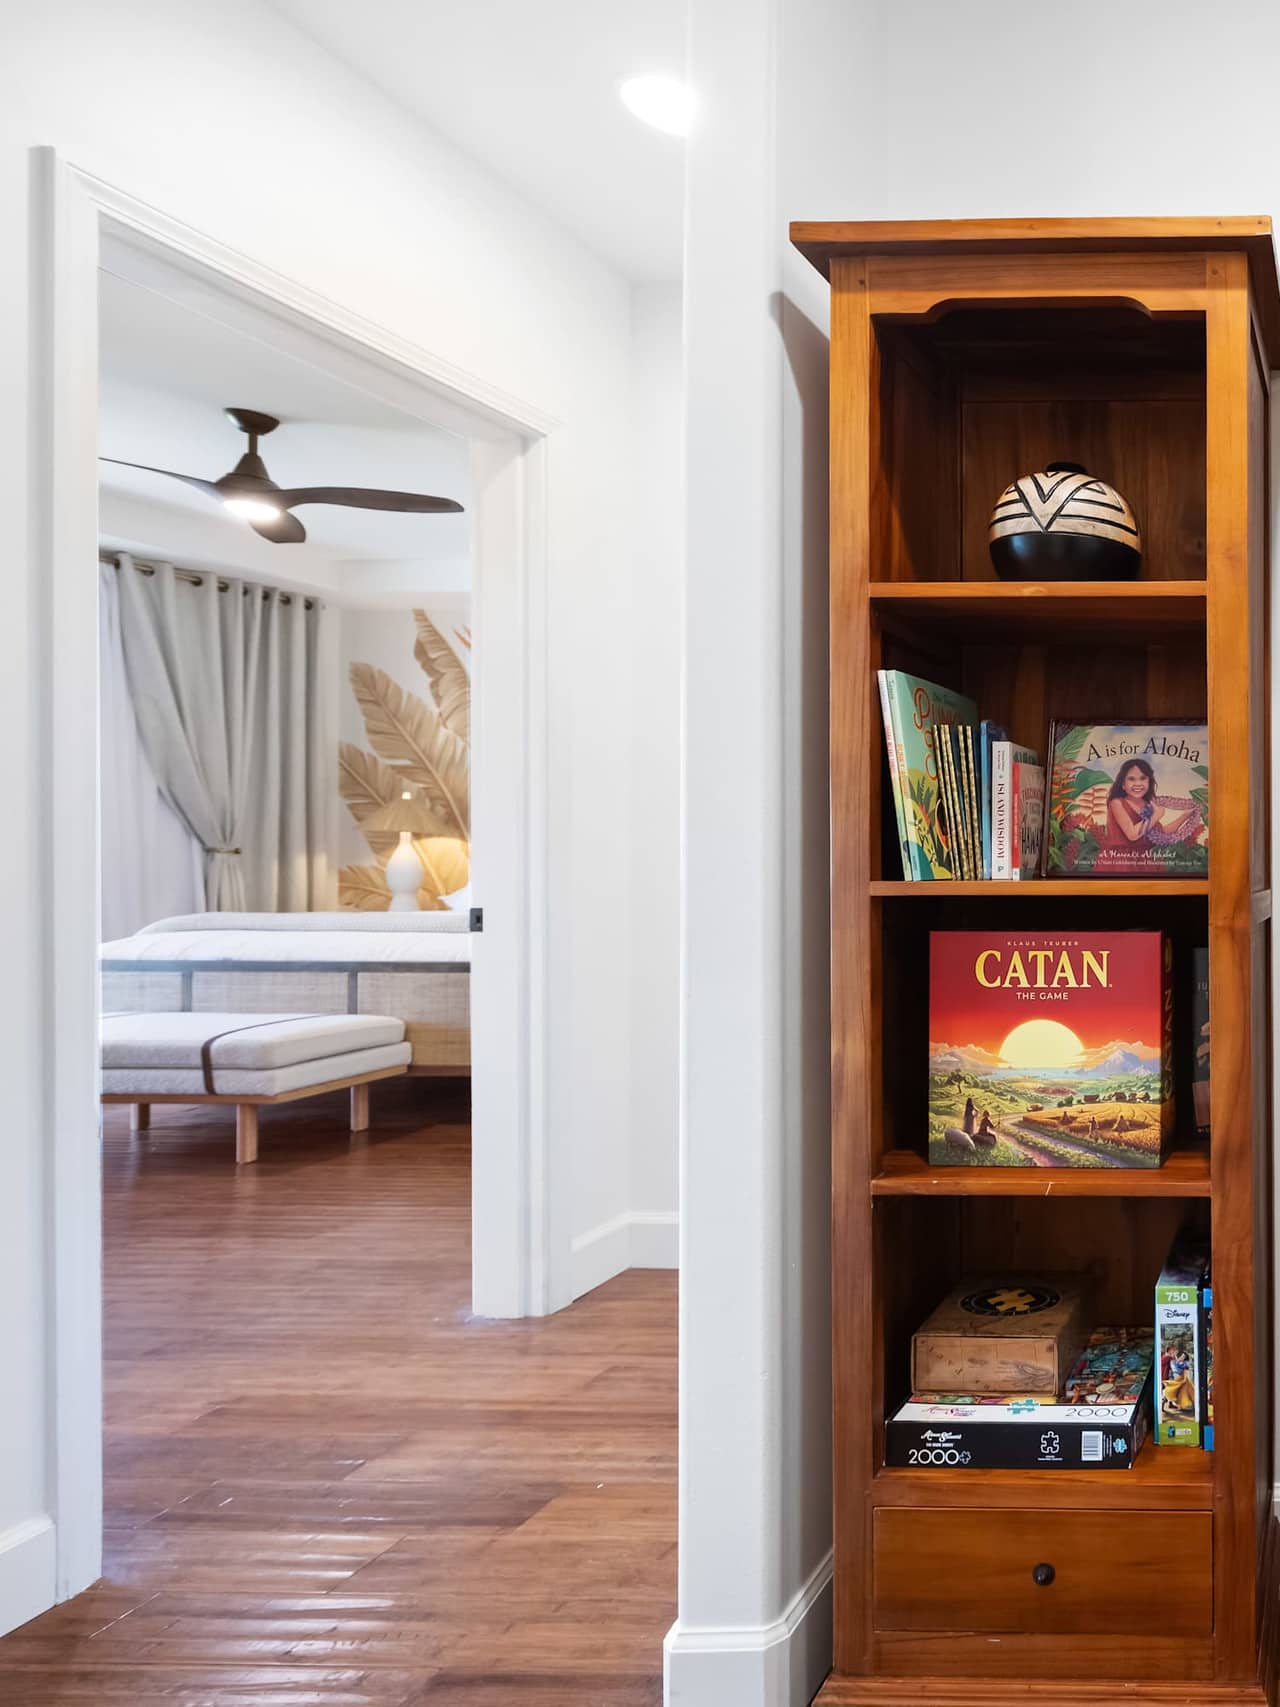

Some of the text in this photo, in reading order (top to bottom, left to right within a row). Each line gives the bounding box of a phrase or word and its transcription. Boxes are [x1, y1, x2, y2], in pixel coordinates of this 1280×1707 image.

[1087, 736, 1200, 763] A is for Aloha
[996, 783, 1006, 816] ISLAND
[996, 818, 1006, 858] WISDOM
[974, 950, 1111, 988] CATAN
[1016, 992, 1069, 1000] THE GAME
[1166, 1292, 1189, 1302] 750
[1164, 1309, 1191, 1322] Disney
[1064, 1407, 1128, 1418] 2000
[908, 1449, 959, 1465] 2000
